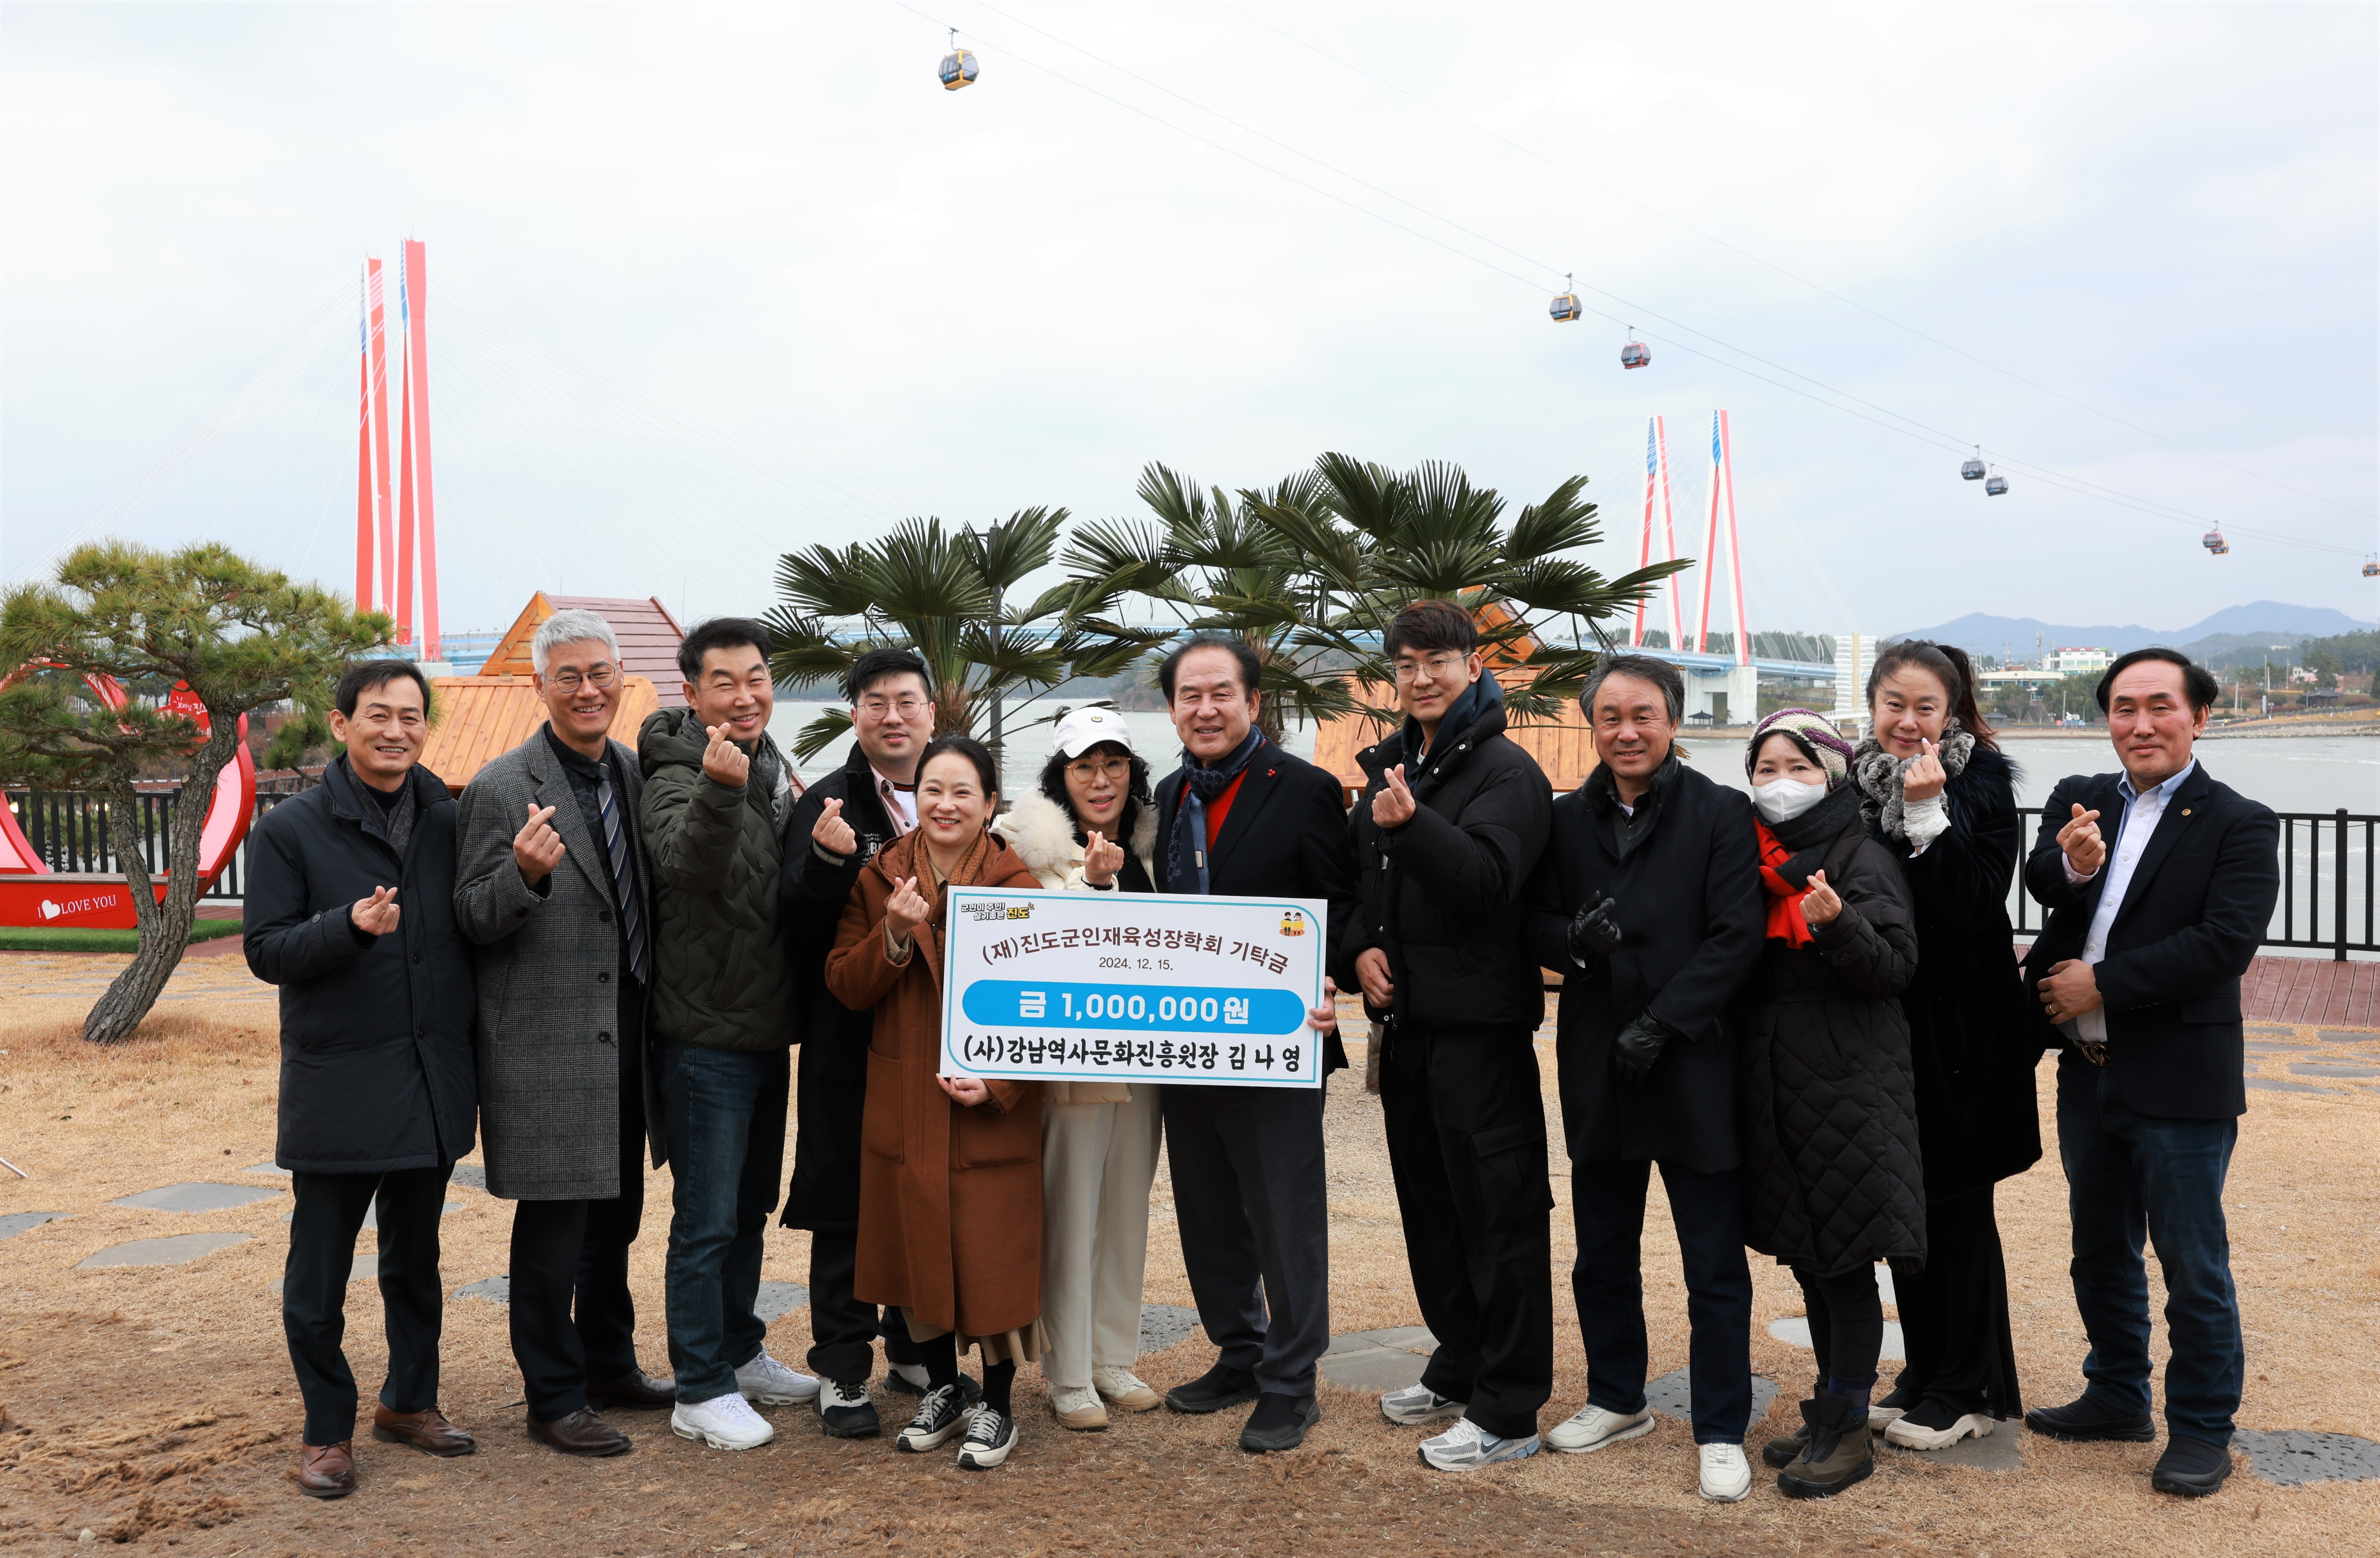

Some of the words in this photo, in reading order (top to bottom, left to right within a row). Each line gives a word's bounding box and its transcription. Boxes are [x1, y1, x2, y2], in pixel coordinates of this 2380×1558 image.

[37, 907, 42, 918] I
[61, 899, 90, 914] LOVE
[92, 895, 116, 908] YOU
[961, 903, 985, 912] 군민이
[986, 902, 1005, 911] 주인!
[974, 911, 1005, 921] 살기좋은
[1007, 907, 1030, 919] 진도
[1099, 957, 1131, 970] 2024.
[1137, 958, 1152, 970] 12.
[1158, 959, 1173, 971] 15.
[1229, 941, 1289, 975] 기탁금
[1020, 991, 1046, 1018] 금
[1061, 993, 1249, 1025] 1,000,000원
[1228, 1043, 1246, 1070] 김
[1255, 1044, 1275, 1071] 나
[1282, 1045, 1300, 1073] 영
